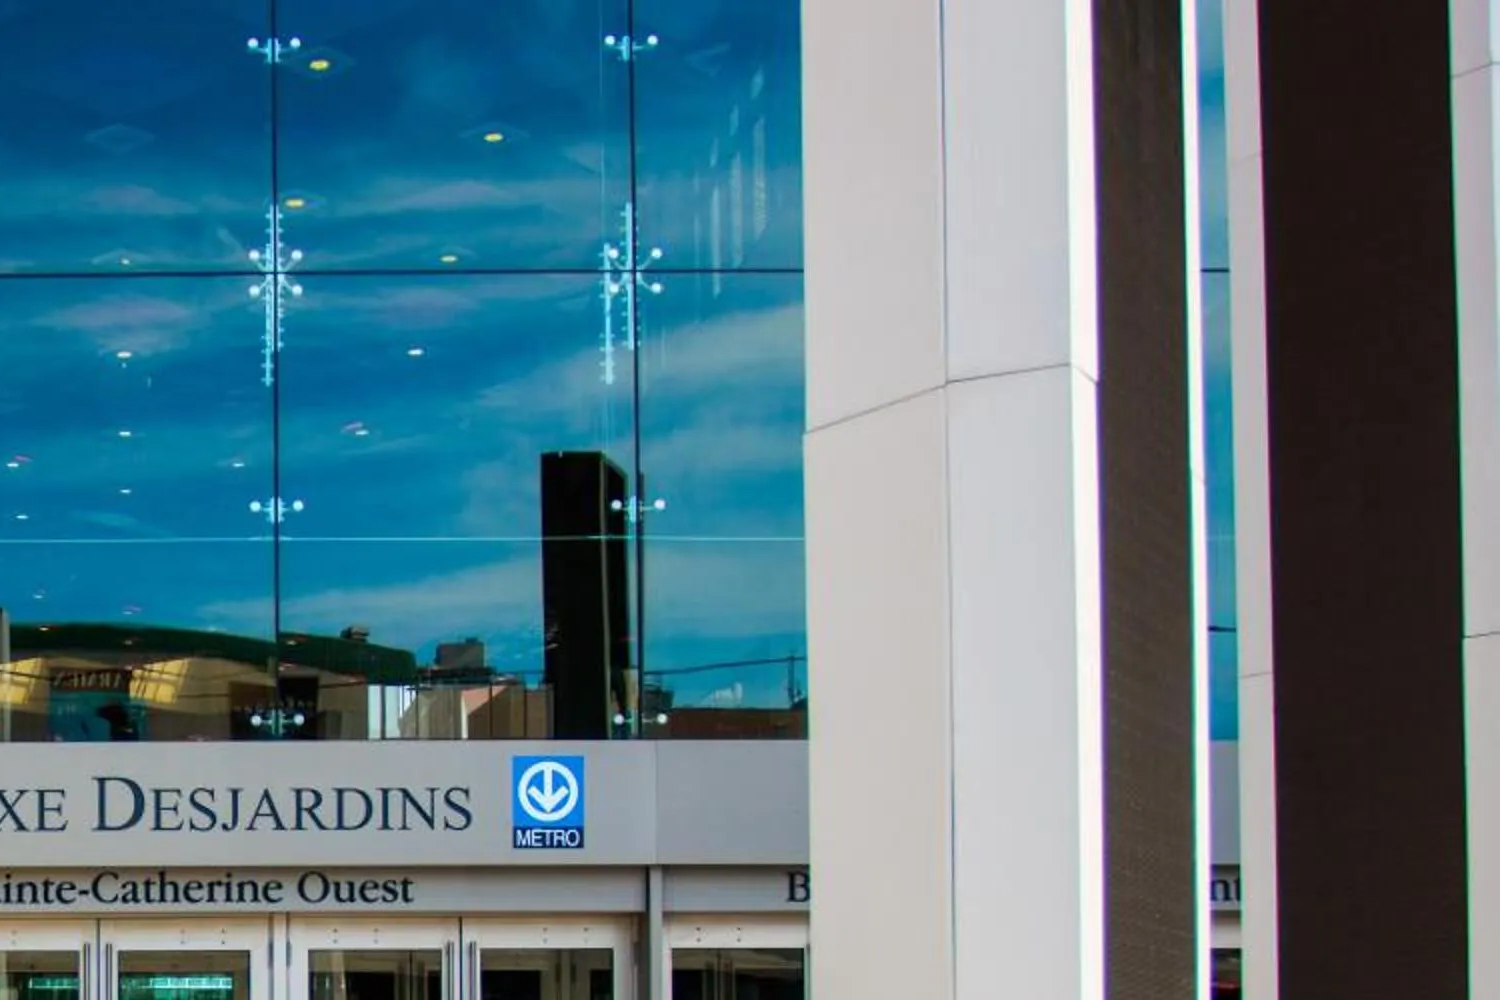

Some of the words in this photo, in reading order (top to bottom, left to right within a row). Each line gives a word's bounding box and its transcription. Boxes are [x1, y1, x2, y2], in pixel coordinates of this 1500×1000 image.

[91, 776, 473, 832] DESJARDINS
[515, 829, 580, 847] METRO
[297, 871, 415, 904] Ouest
